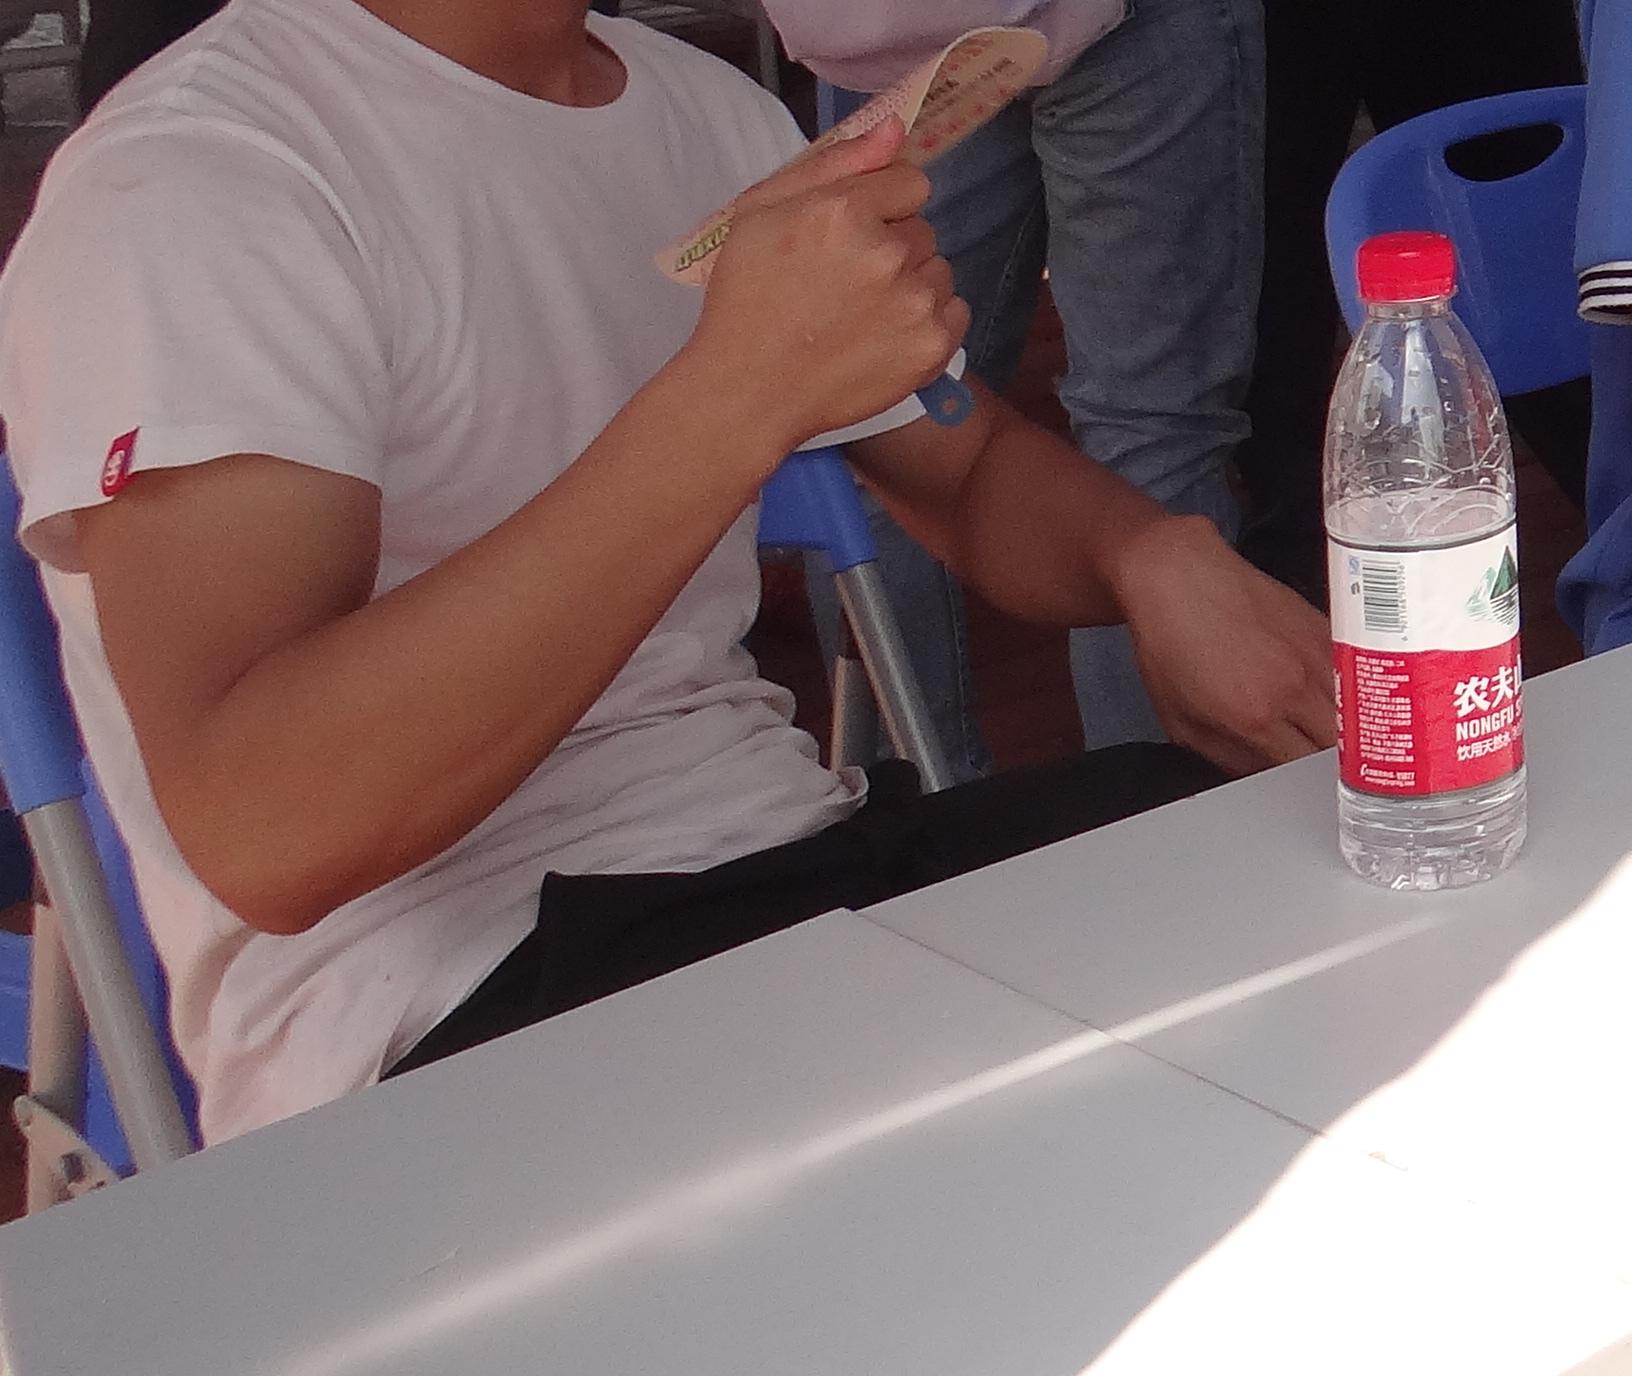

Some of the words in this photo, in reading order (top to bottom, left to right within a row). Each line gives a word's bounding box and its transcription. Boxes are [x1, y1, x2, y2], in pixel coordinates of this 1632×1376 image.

[1455, 704, 1515, 742] NONGFU
[1457, 731, 1512, 762] 饮用天然水
